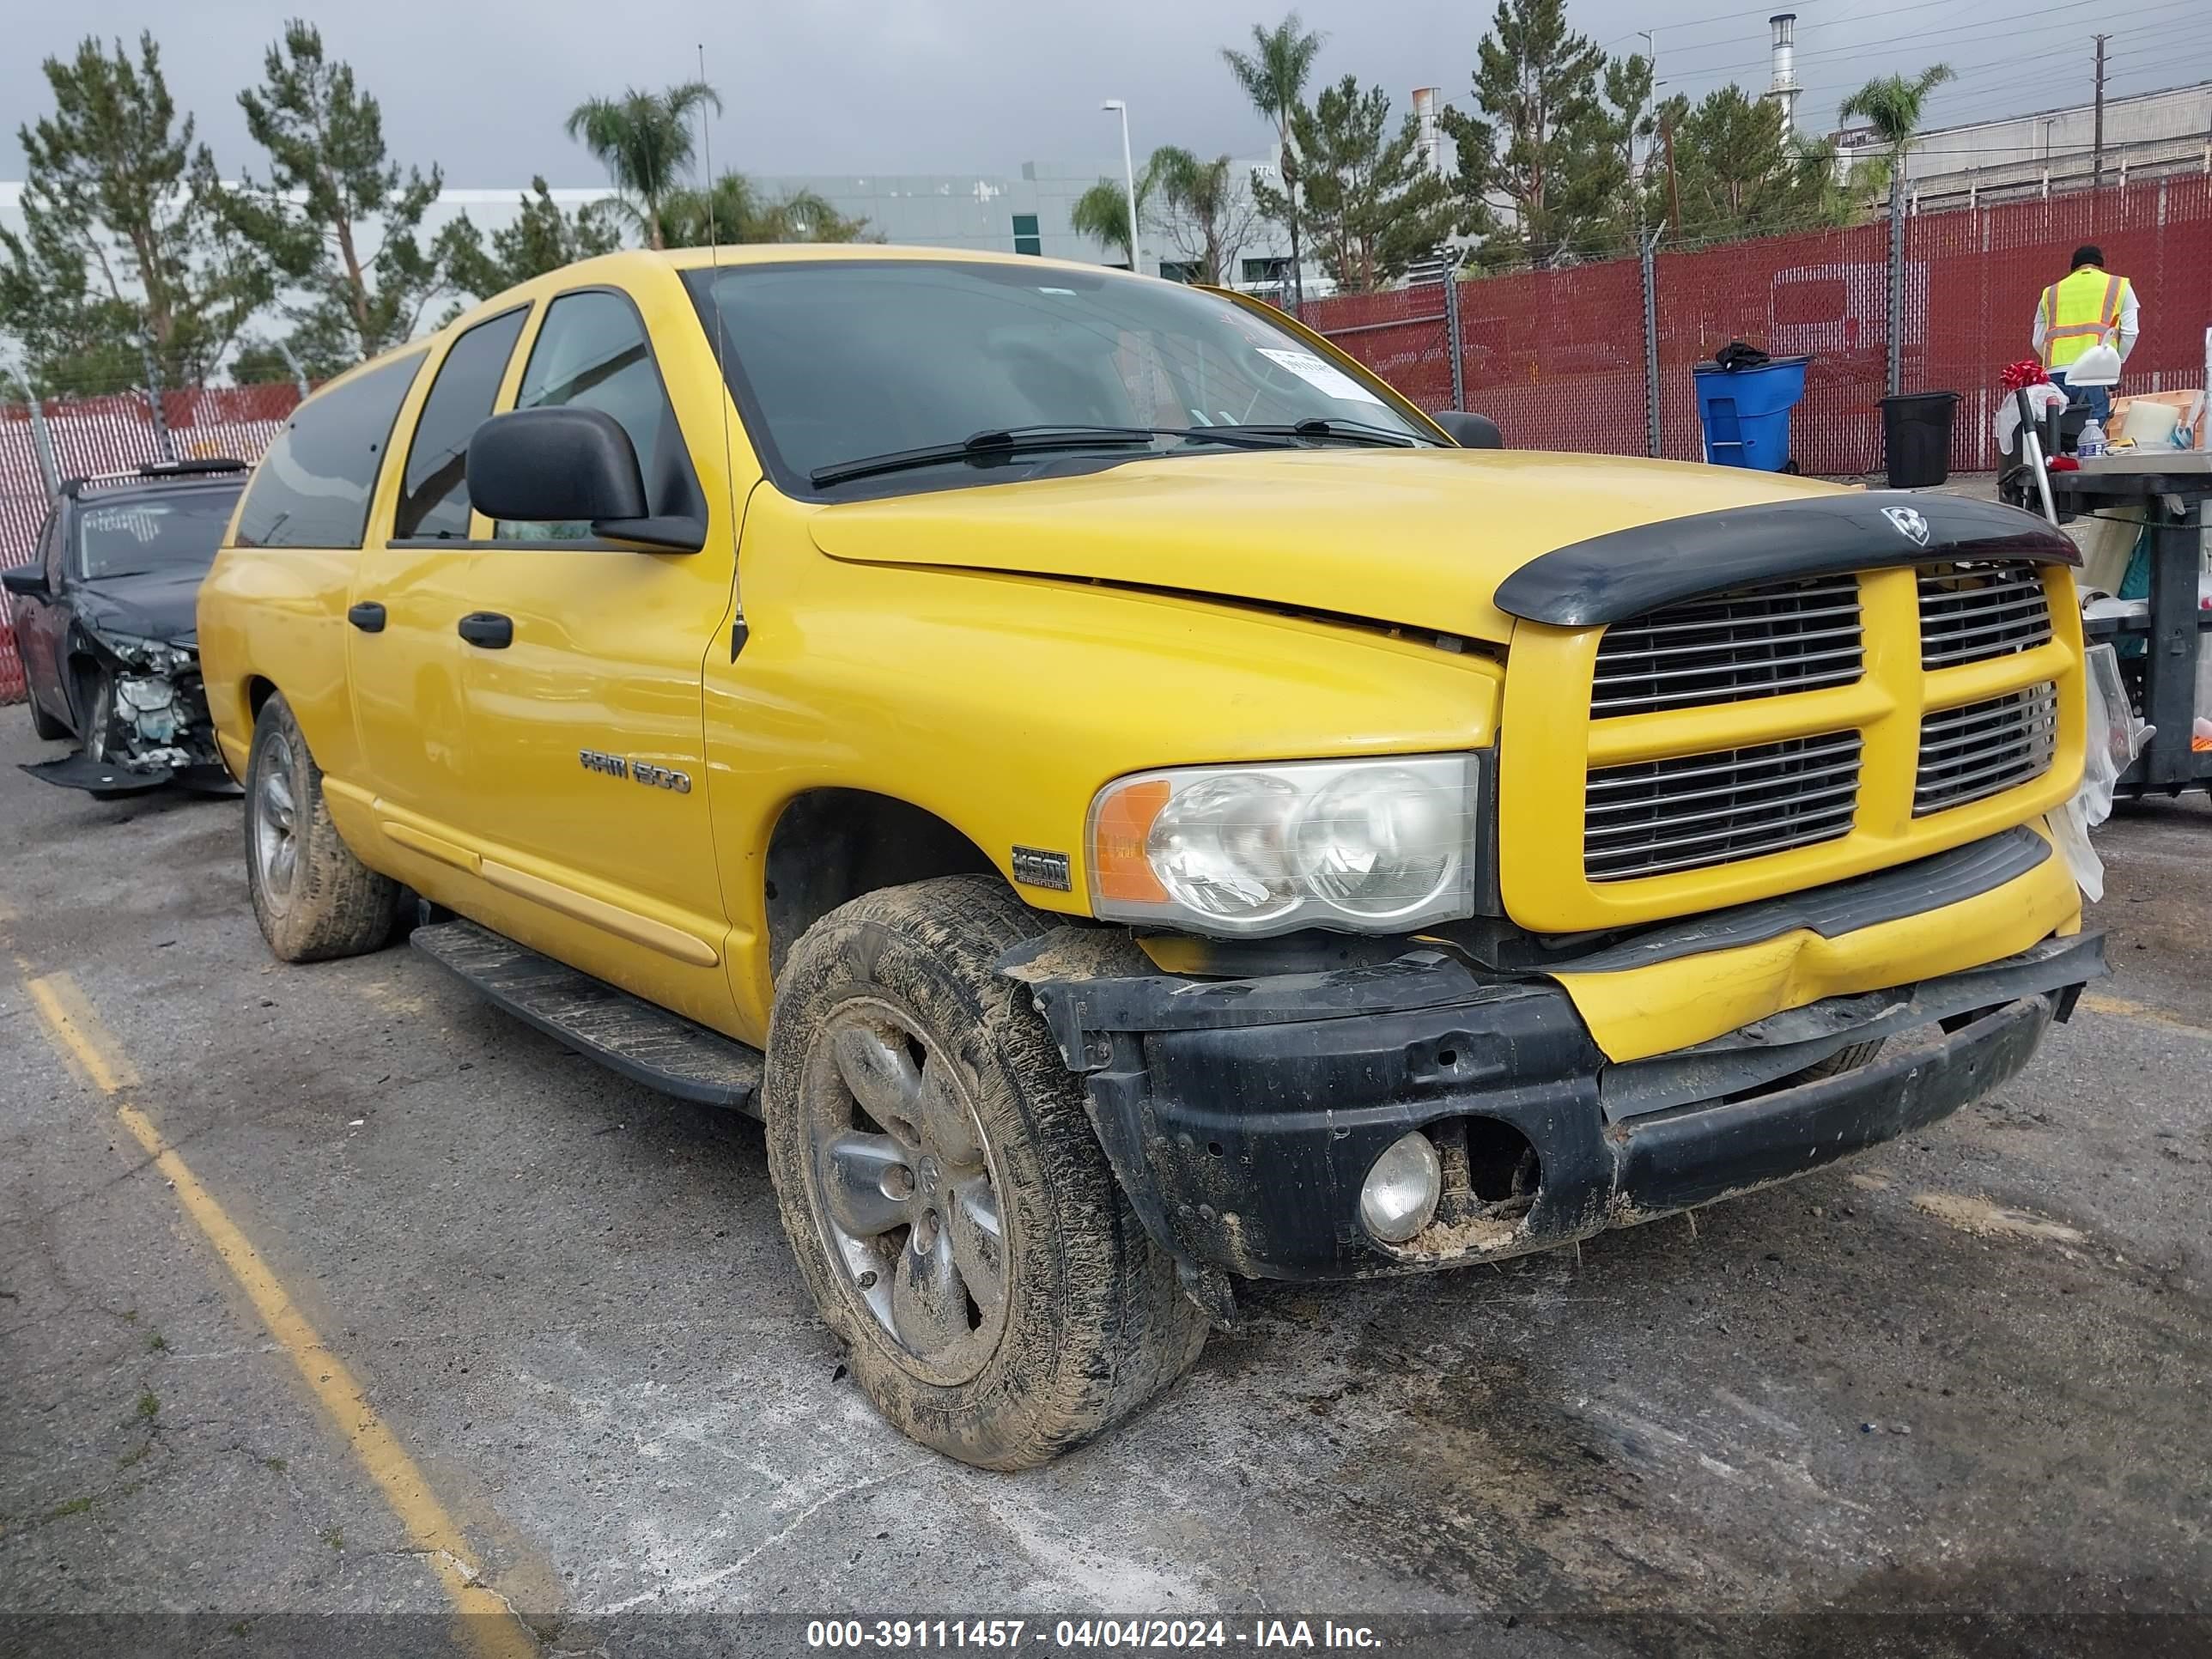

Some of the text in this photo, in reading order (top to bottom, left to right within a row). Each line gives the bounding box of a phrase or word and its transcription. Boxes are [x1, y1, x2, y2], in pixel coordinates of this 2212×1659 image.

[579, 749, 691, 793] RAM 1500
[1012, 853, 1070, 884] HEMI
[1018, 876, 1064, 890] MAGNUM
